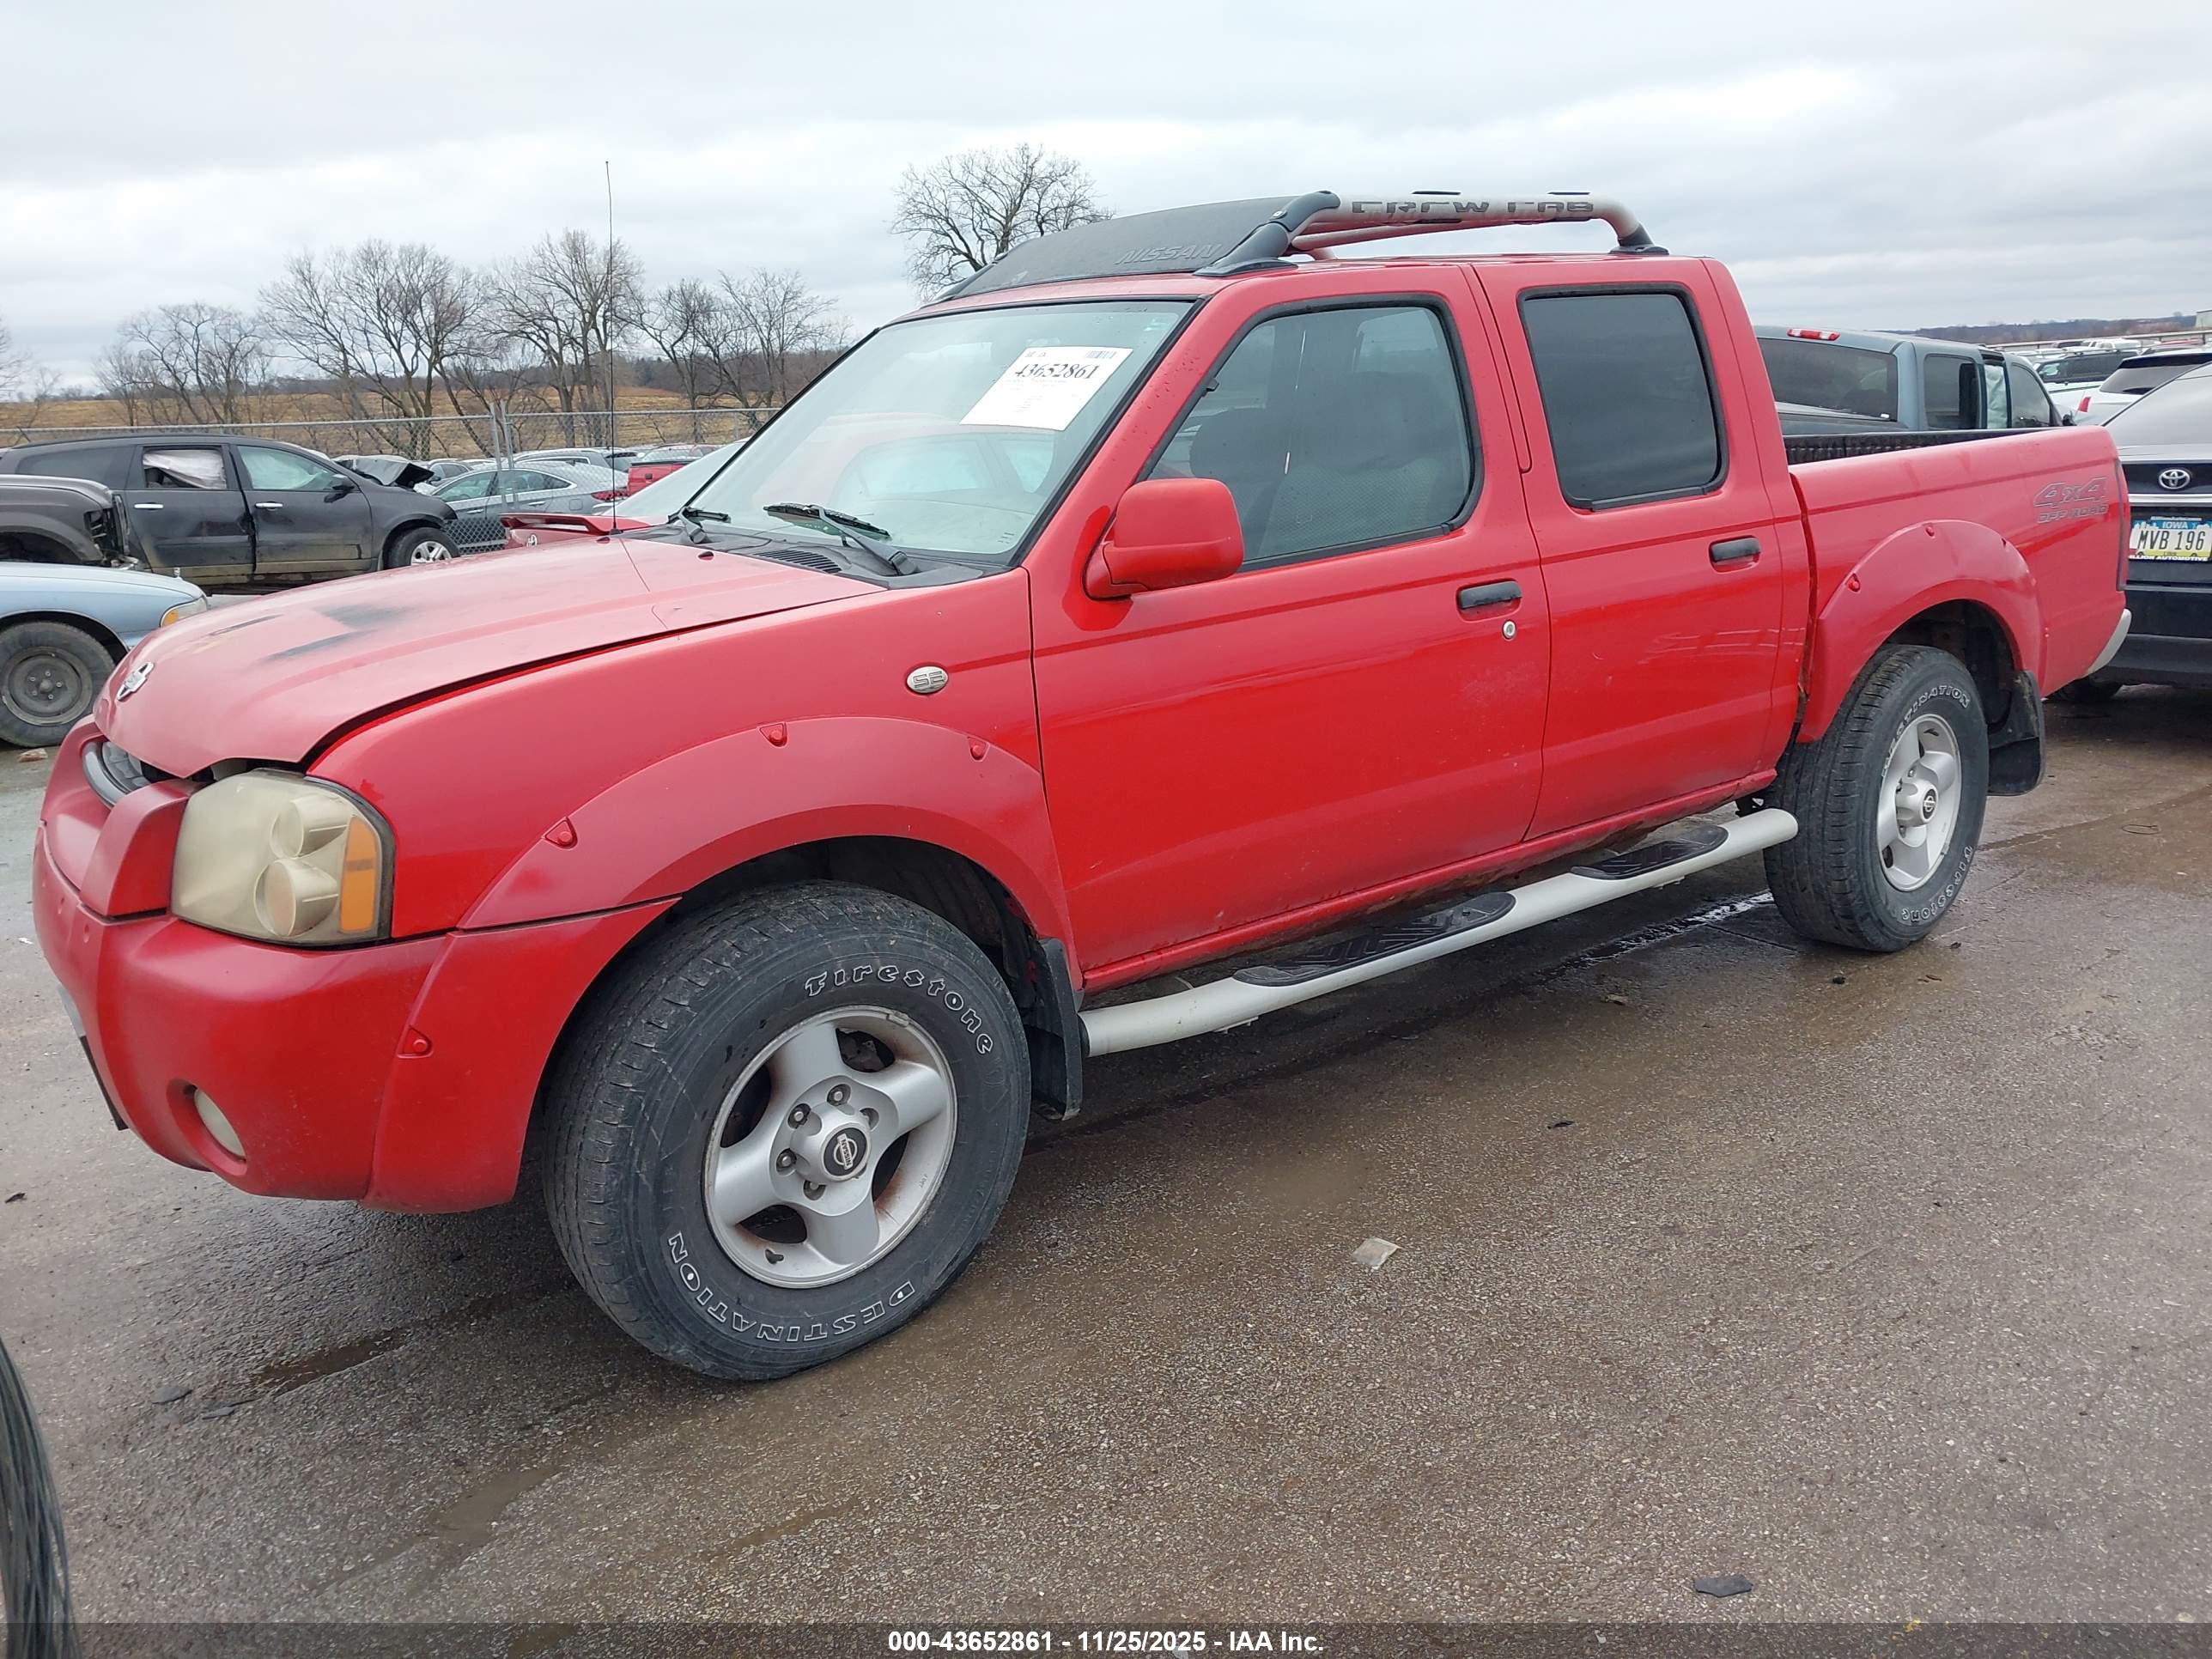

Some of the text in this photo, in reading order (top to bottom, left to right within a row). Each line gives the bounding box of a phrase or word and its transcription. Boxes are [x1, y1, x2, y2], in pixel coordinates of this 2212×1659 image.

[1115, 243, 1222, 265] NISSAN
[1015, 363, 1100, 379] 43652861
[2137, 530, 2206, 550] MVB 196
[913, 671, 945, 689] SE
[805, 964, 994, 1054] Firestone
[667, 1231, 916, 1343] DESTINATION
